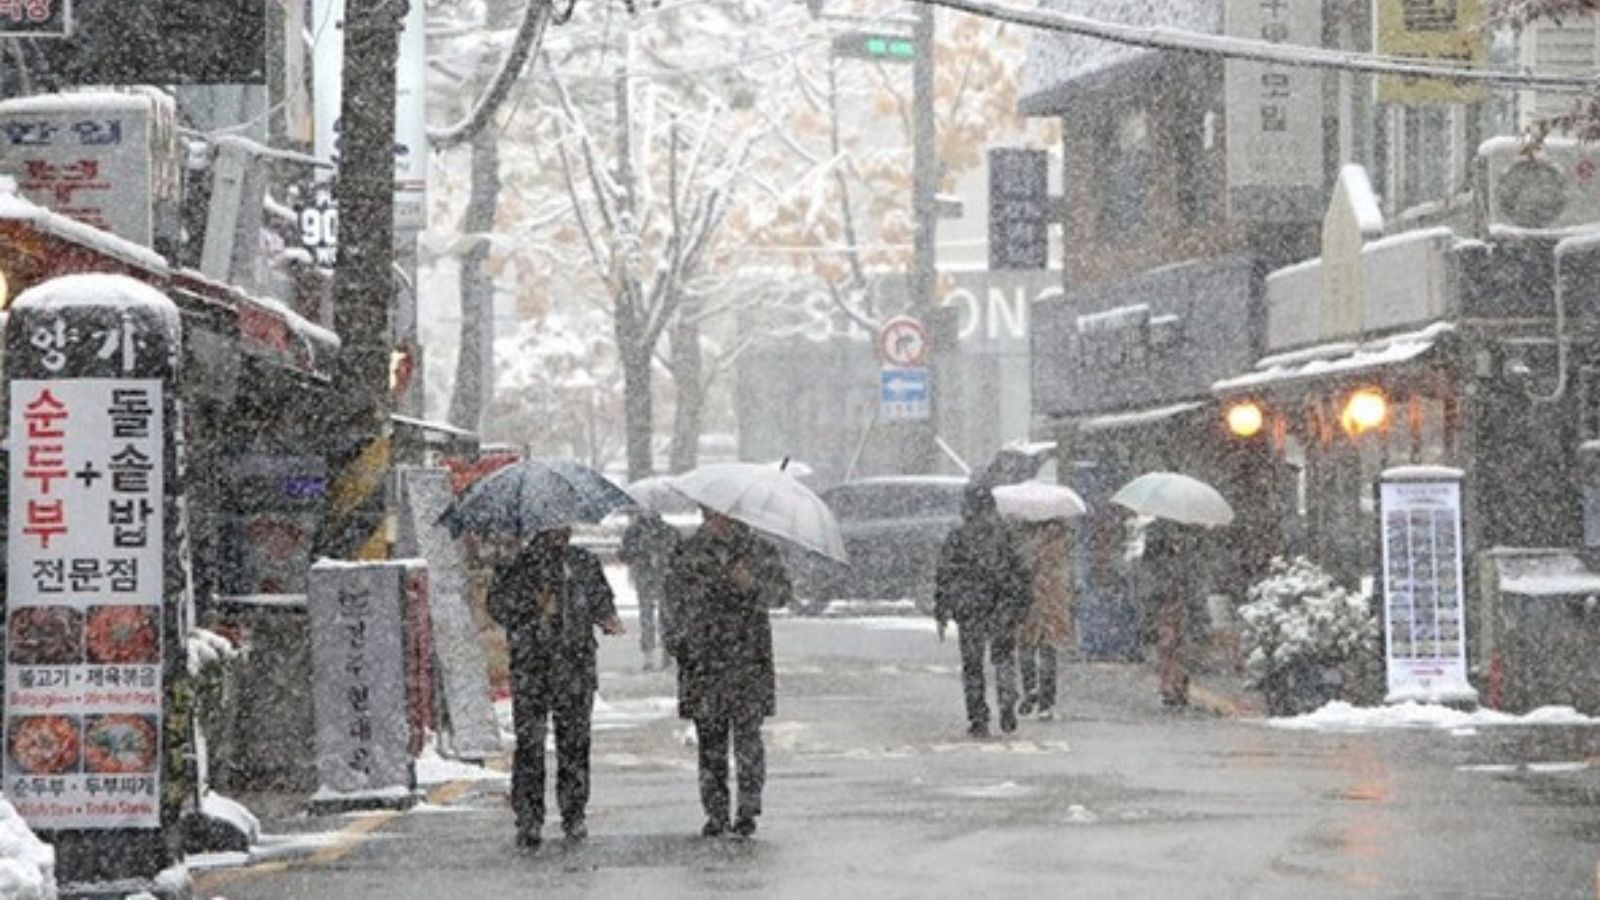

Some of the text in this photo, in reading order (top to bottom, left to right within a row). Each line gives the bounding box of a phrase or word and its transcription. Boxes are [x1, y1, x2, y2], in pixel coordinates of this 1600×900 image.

[31, 315, 147, 371] 양가
[23, 388, 68, 548] 순두부
[107, 388, 154, 548] 돌솥밥
[32, 558, 138, 592] 전문점
[19, 669, 70, 687] 불고기
[13, 777, 65, 798] 순두부
